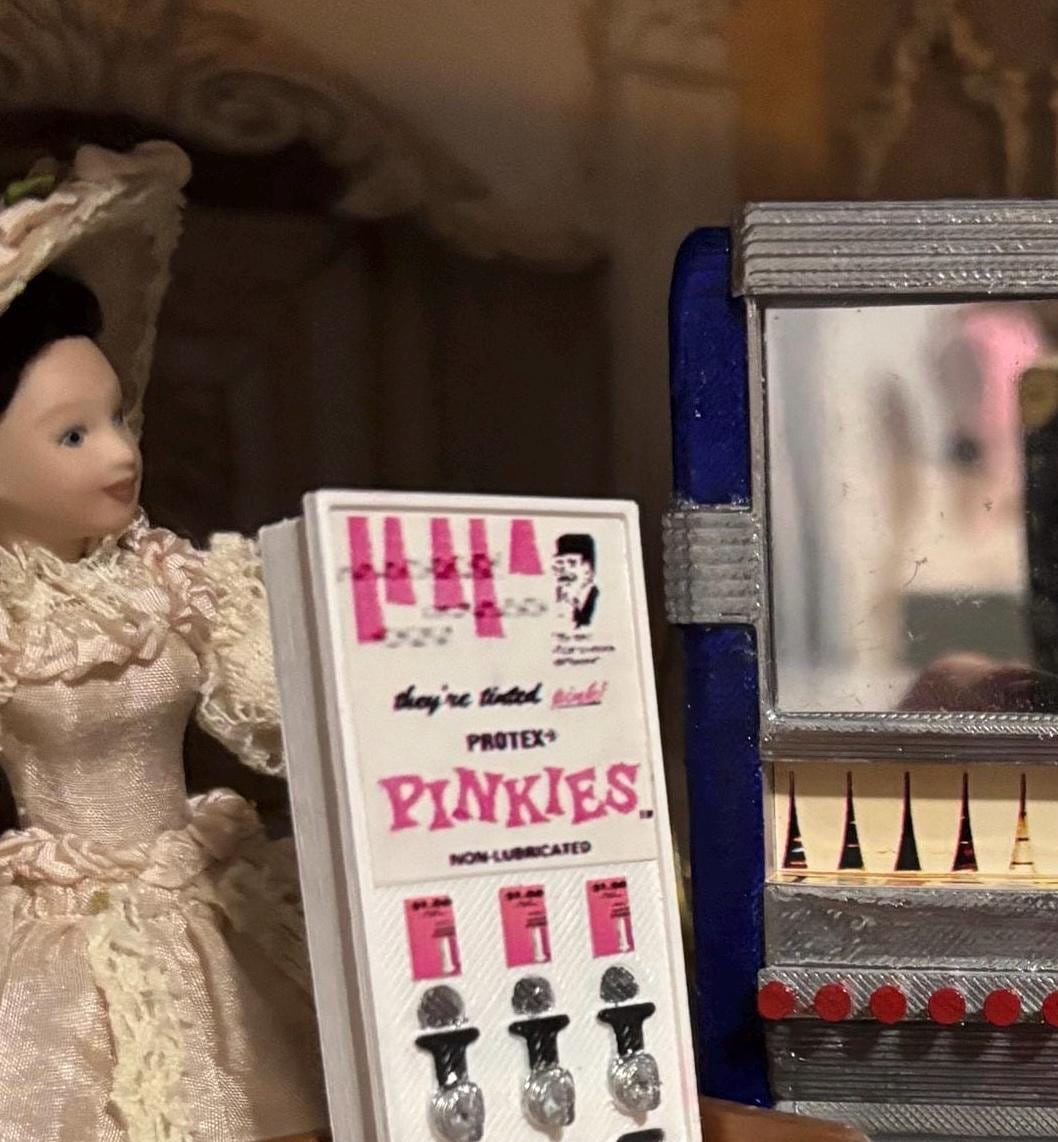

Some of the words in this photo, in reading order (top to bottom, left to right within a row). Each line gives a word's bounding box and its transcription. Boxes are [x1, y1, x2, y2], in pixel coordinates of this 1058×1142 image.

[394, 683, 472, 715] they're
[478, 682, 543, 707] tinted
[377, 763, 641, 833] PINKIES
[449, 840, 591, 866] NON-LUBRICATED
